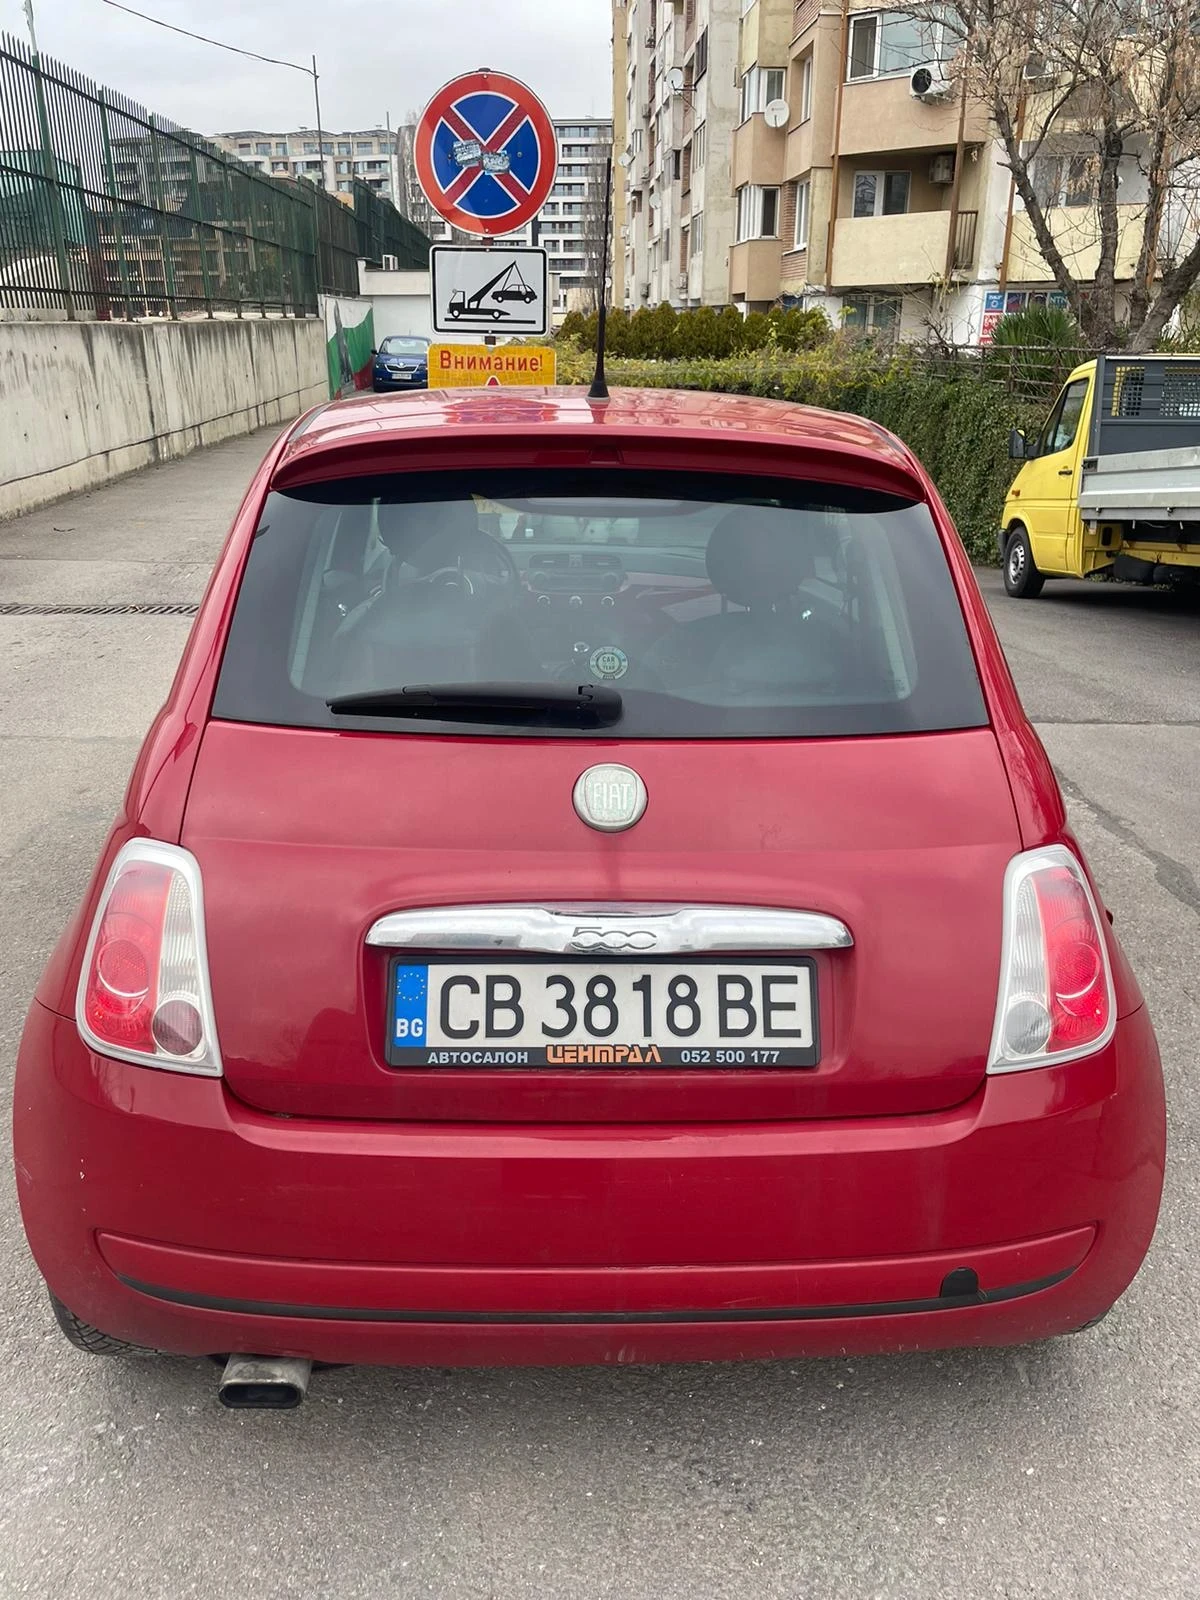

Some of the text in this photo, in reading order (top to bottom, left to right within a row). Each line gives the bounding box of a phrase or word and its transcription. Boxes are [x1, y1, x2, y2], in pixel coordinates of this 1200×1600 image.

[440, 350, 543, 372] Внимание!
[592, 783, 630, 810] FIAT
[571, 927, 658, 950] 500
[440, 974, 802, 1038] CB 3818 BE
[396, 1018, 423, 1038] BG
[428, 1051, 529, 1063] АВТОСАЛОН
[680, 1050, 712, 1063] 052
[715, 1050, 746, 1063] 500
[750, 1050, 780, 1063] 177
